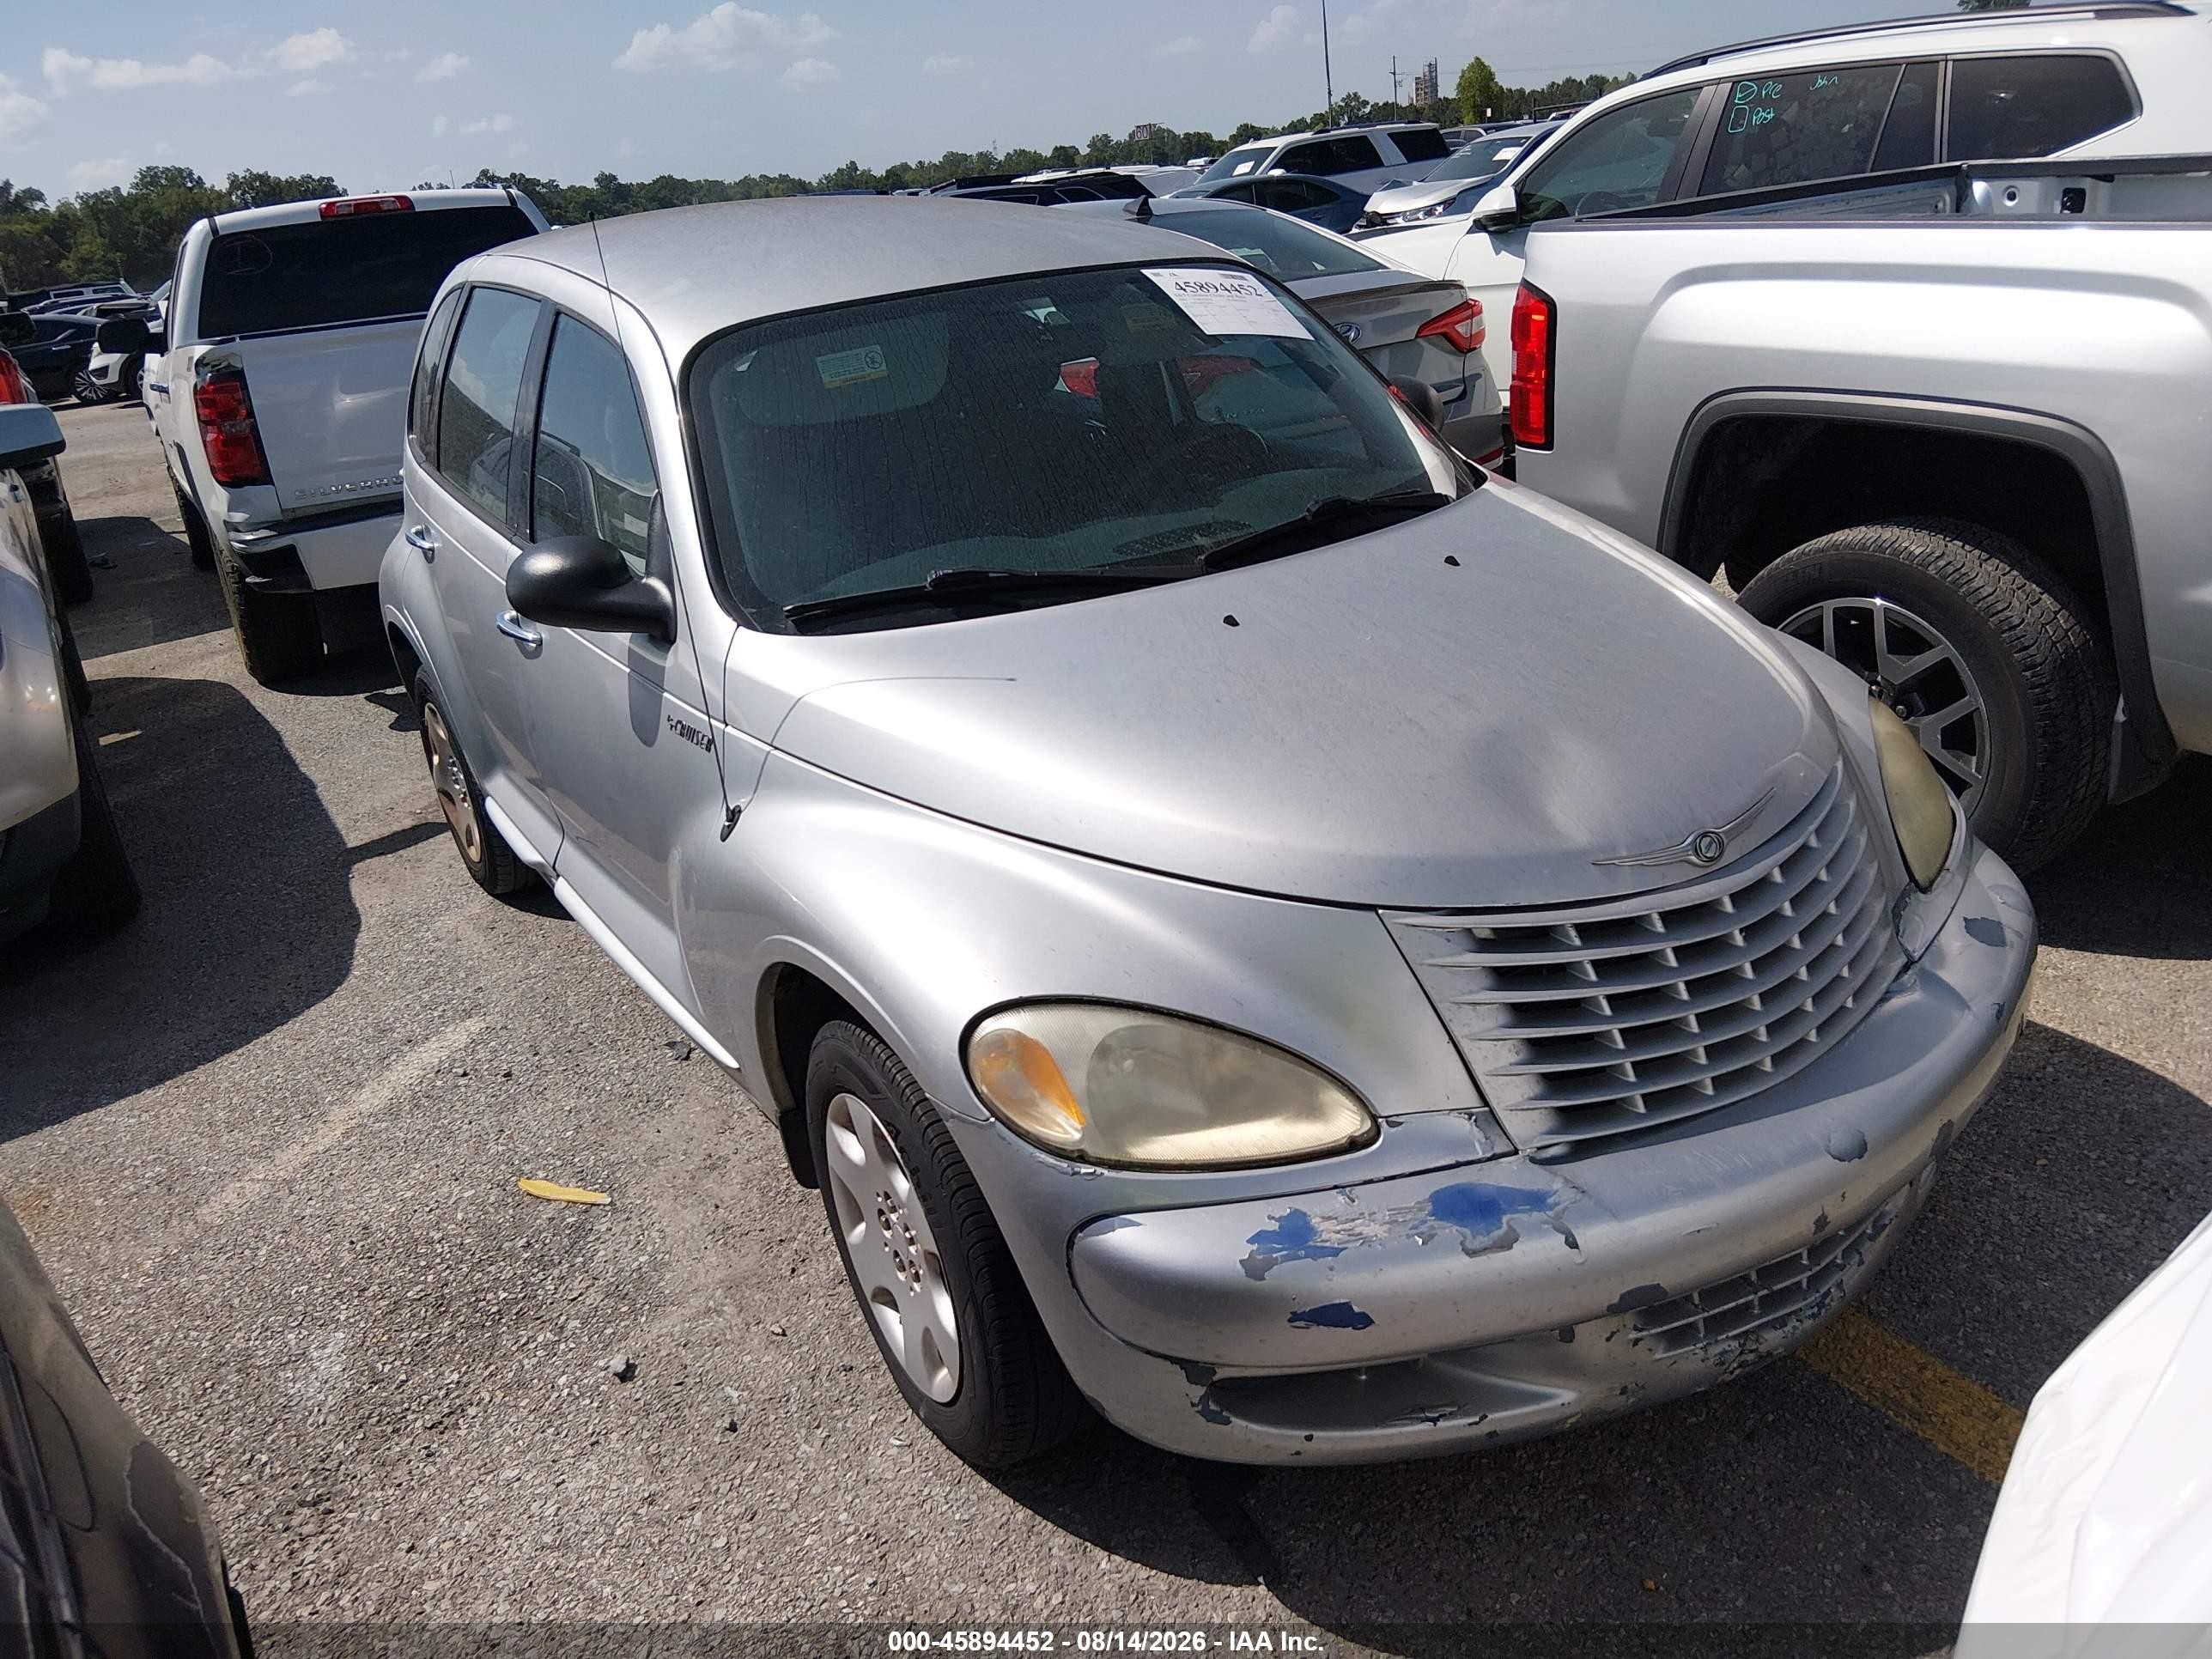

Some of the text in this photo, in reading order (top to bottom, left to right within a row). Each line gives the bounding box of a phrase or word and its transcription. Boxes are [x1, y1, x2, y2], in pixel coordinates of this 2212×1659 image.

[1762, 81, 1783, 99] Pre
[1135, 125, 1148, 139] 60
[1175, 281, 1264, 297] 45894452
